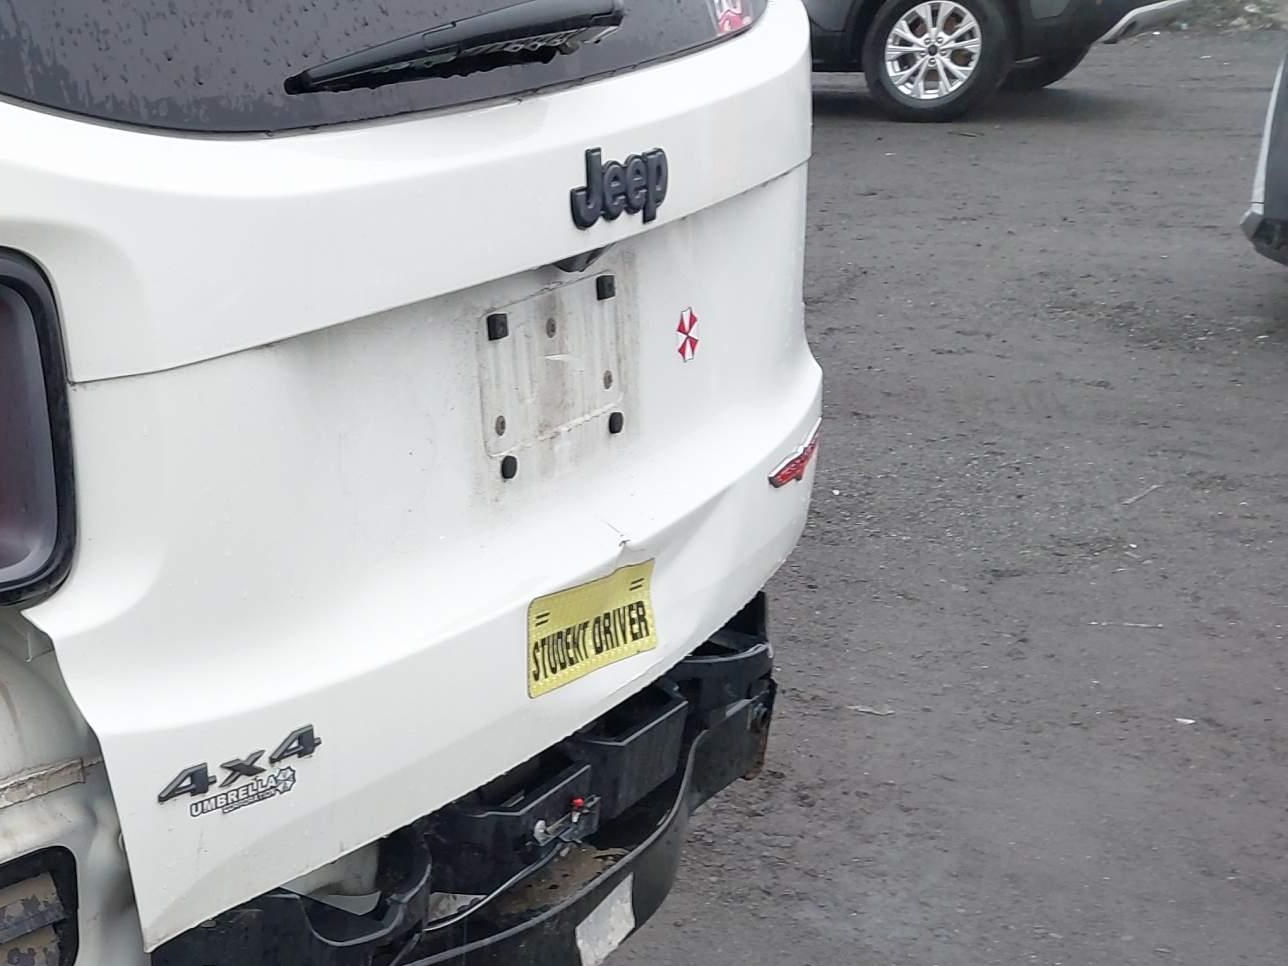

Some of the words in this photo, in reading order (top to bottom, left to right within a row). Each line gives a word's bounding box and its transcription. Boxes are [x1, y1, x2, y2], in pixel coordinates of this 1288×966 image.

[570, 147, 669, 231] Jeep
[532, 621, 590, 681] STUDENT
[592, 601, 650, 655] DRIVER
[190, 774, 278, 817] UMBRELLA
